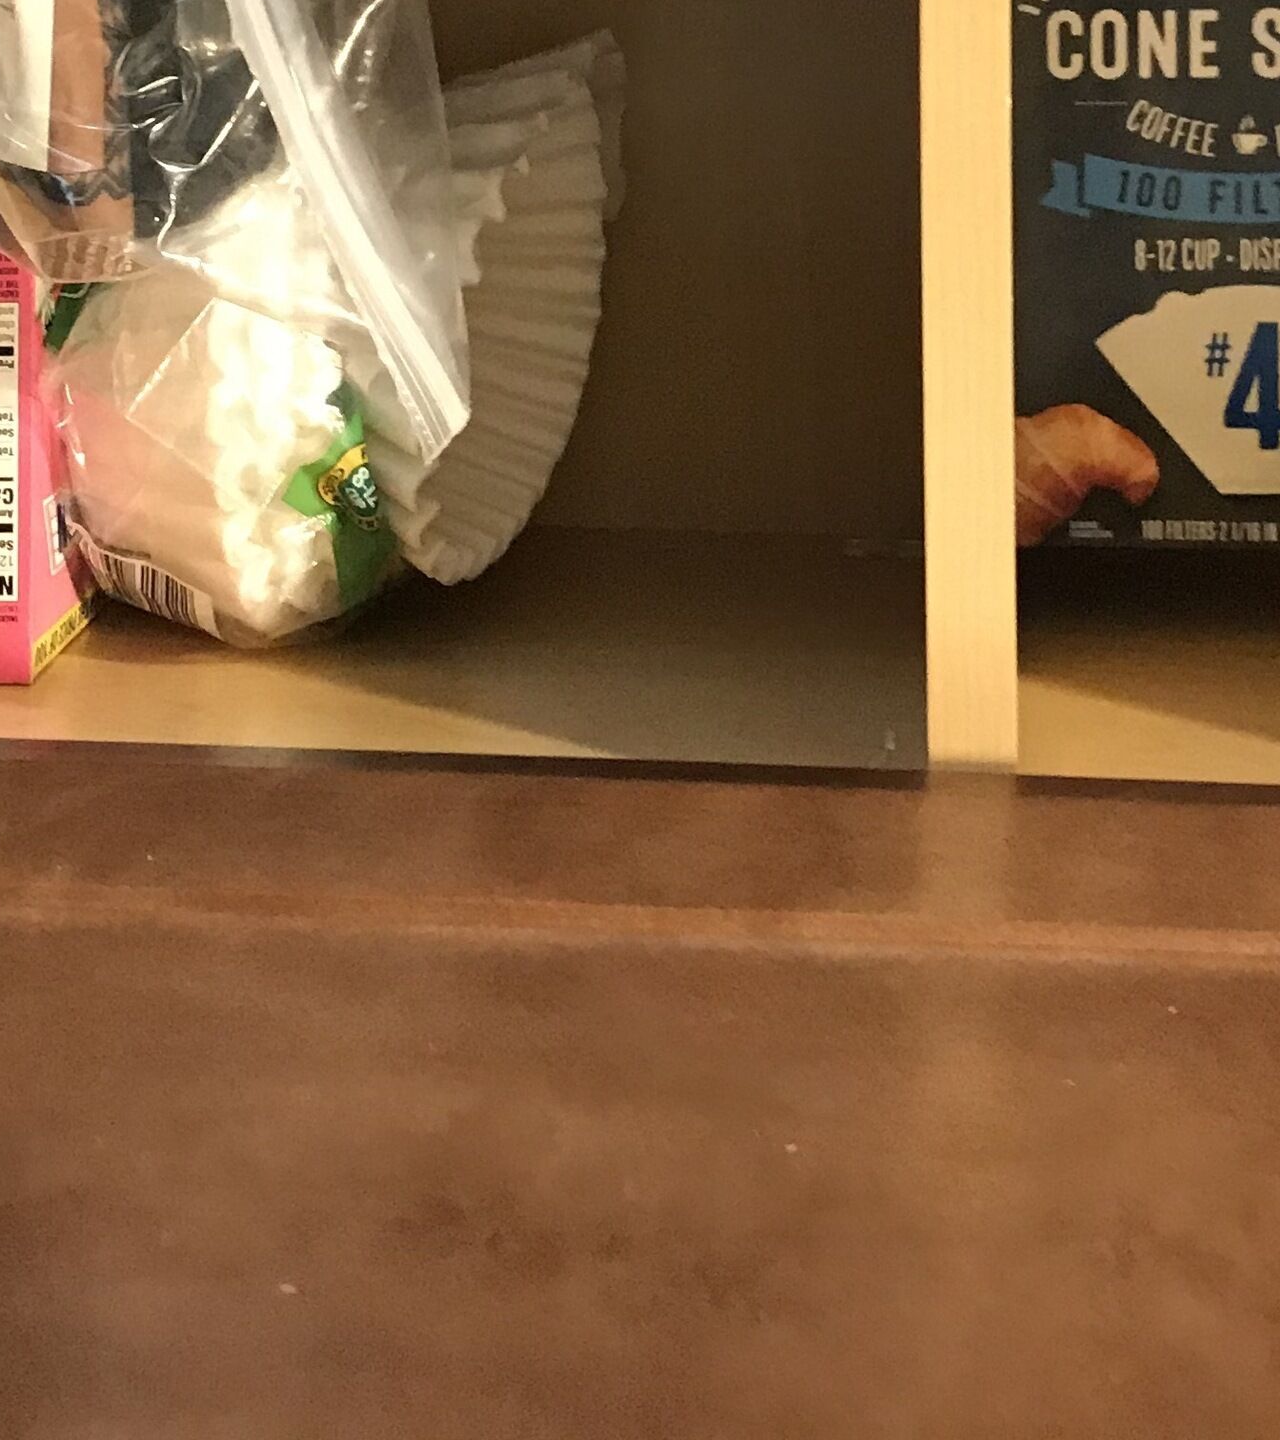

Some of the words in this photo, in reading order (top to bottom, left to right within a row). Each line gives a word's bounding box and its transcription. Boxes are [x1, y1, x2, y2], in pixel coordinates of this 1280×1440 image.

[1045, 6, 1220, 80] CONE
[1125, 98, 1219, 158] COFFEE
[1119, 172, 1182, 209] 100
[1134, 238, 1177, 272] 8-12
[1181, 238, 1220, 272] CUP
